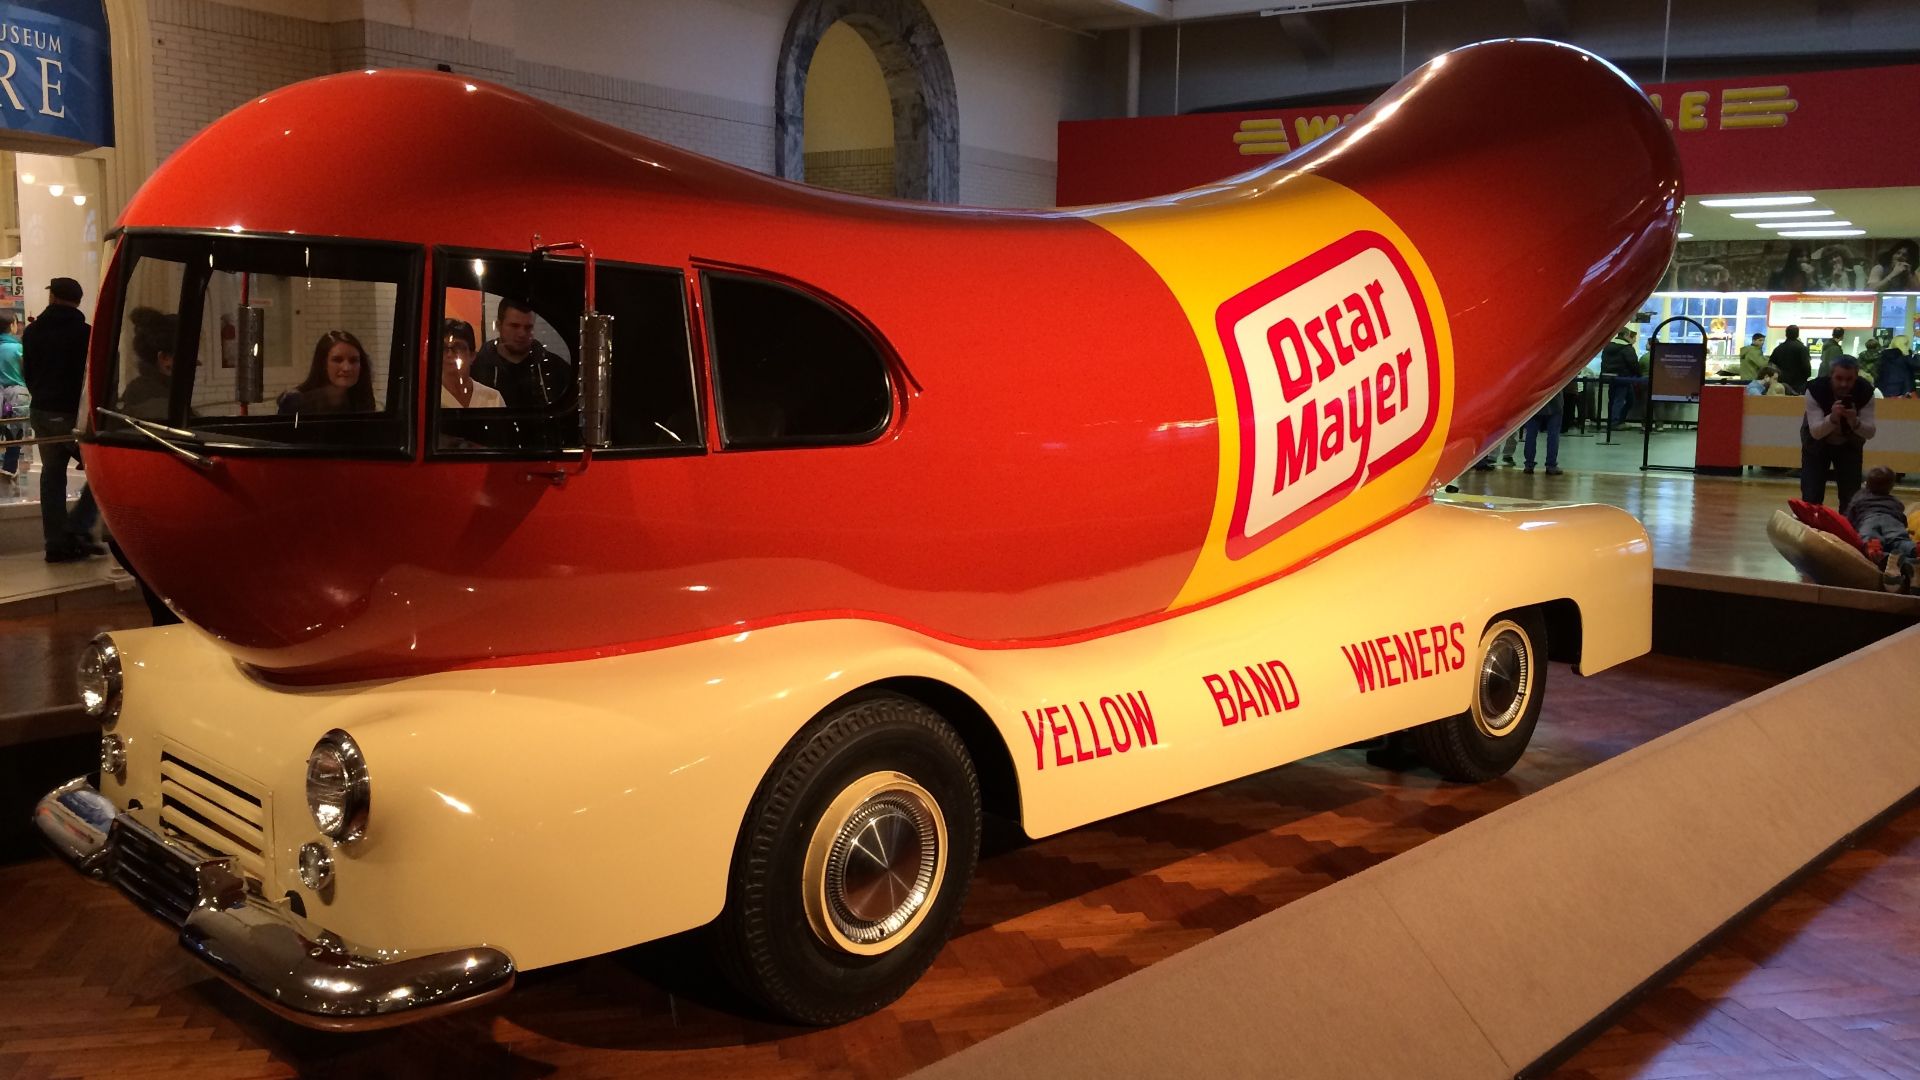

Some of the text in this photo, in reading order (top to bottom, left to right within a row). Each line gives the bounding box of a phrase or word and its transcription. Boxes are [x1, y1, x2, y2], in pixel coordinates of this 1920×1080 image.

[1267, 279, 1391, 403] Oscar
[1272, 348, 1412, 497] Mayer
[1022, 622, 1465, 770] YELLOW BAND WIENERS
